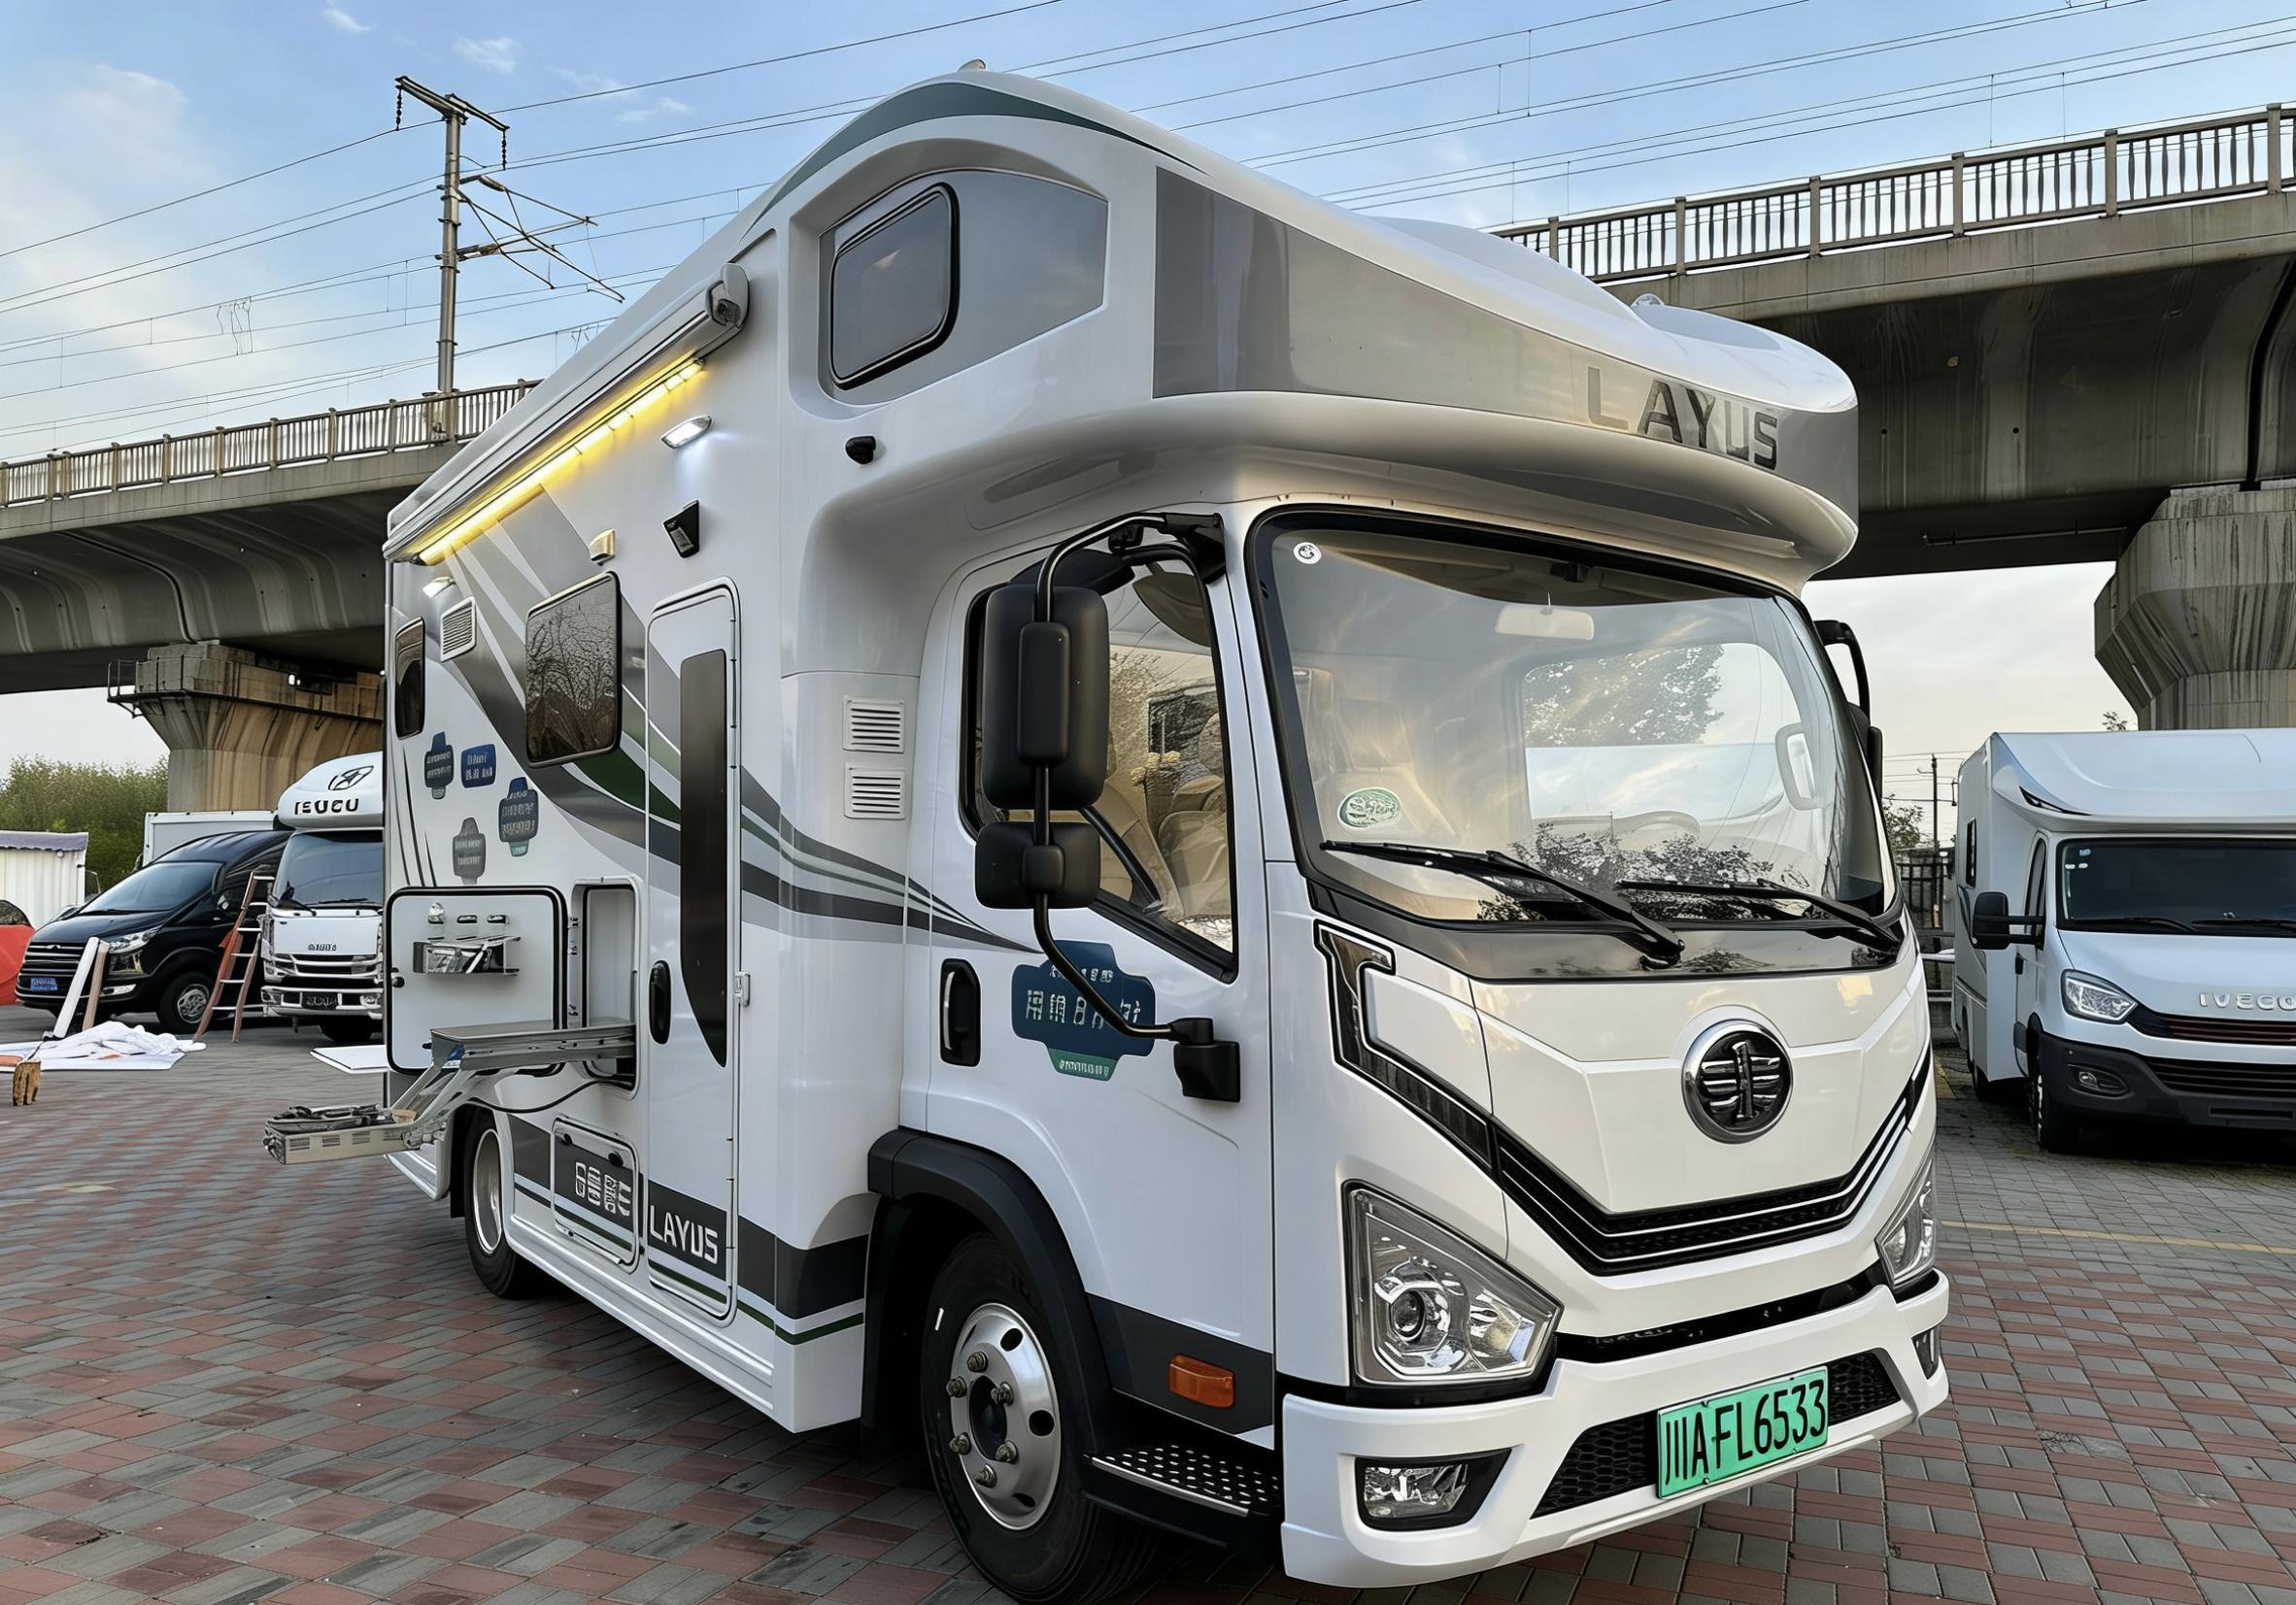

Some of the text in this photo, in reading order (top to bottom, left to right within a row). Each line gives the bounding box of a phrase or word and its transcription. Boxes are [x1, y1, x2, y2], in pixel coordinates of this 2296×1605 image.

[1587, 366, 1778, 471] LAYUS
[2199, 992, 2296, 1011] IVECO
[650, 1204, 719, 1265] LAYUS
[1665, 1379, 1826, 1486] 川AFL6533
